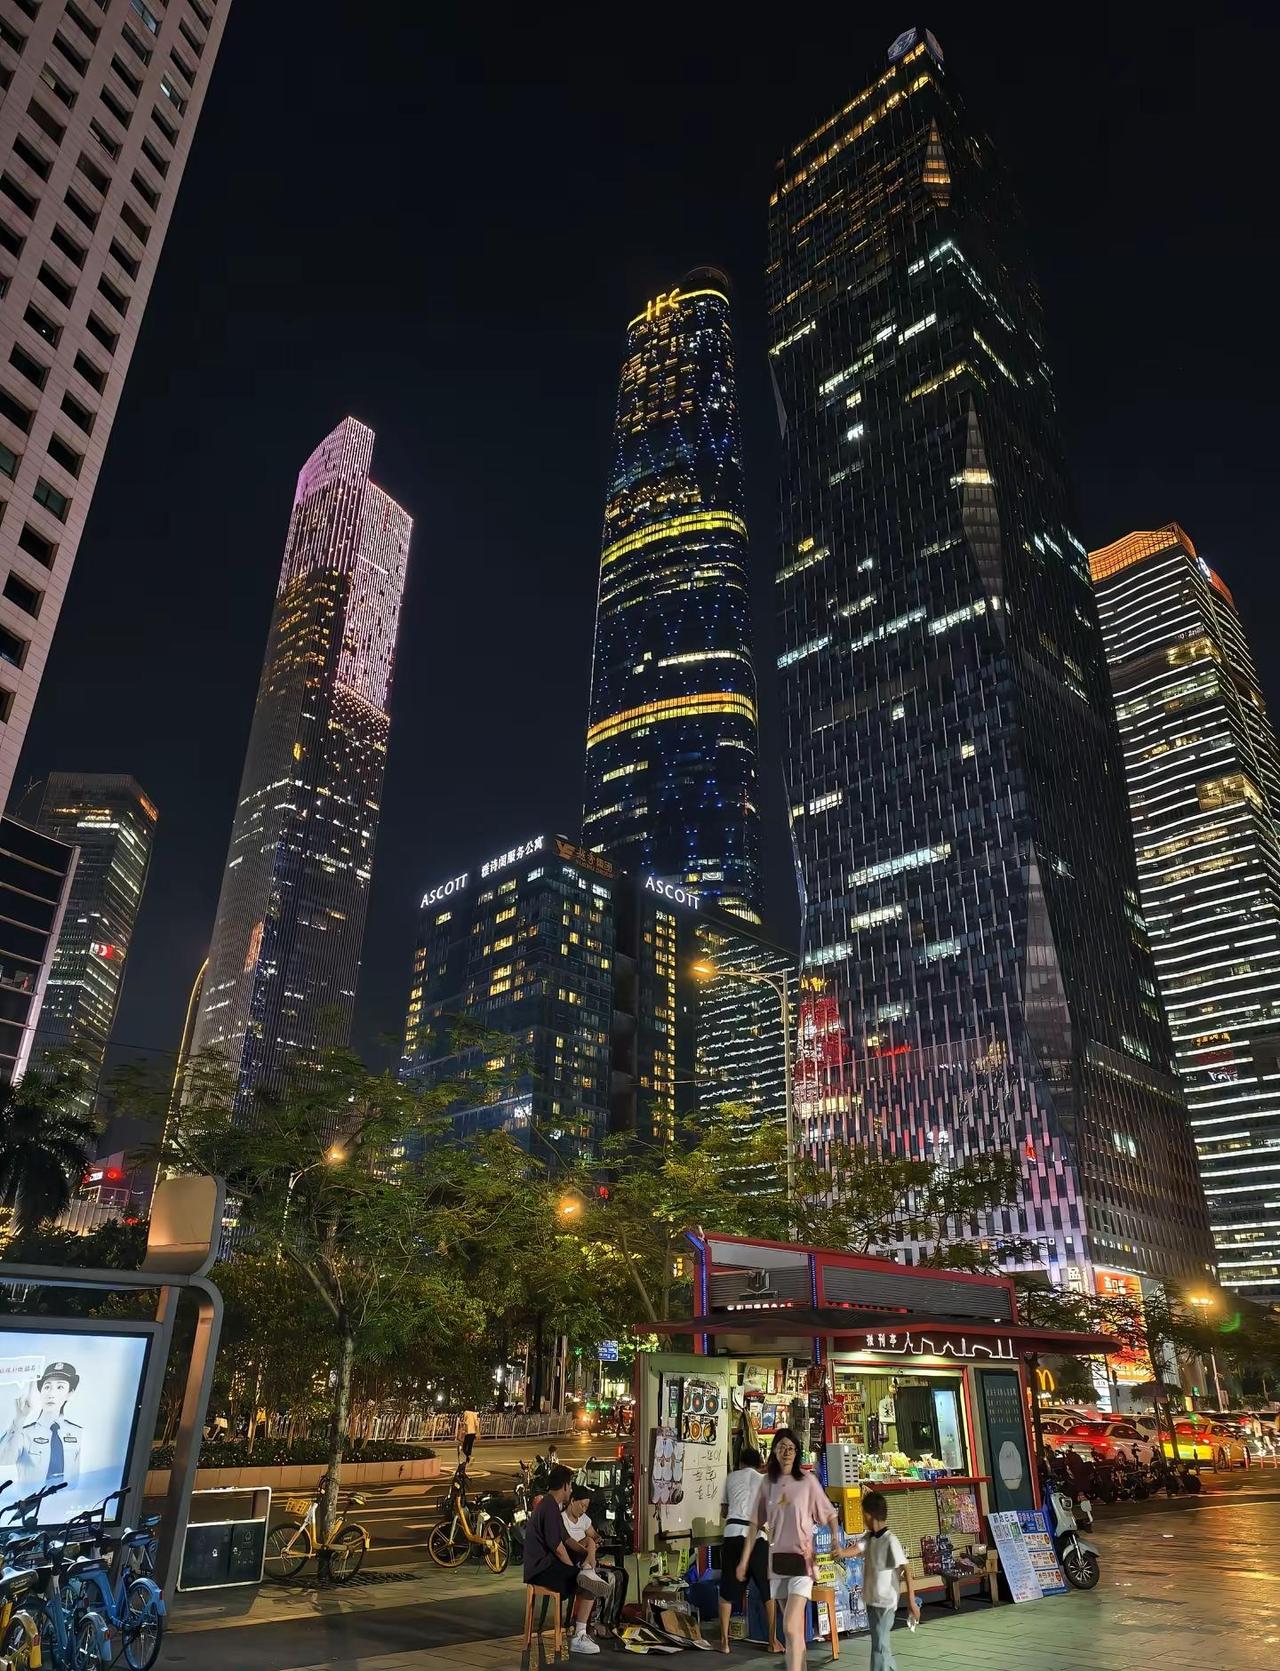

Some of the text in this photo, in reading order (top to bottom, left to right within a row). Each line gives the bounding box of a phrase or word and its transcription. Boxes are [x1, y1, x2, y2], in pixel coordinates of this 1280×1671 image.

[646, 287, 680, 322] IFC
[481, 835, 544, 879] 雅诗阁服务公寓
[420, 873, 468, 908] ASCOTT
[645, 876, 700, 910] ASCOTT
